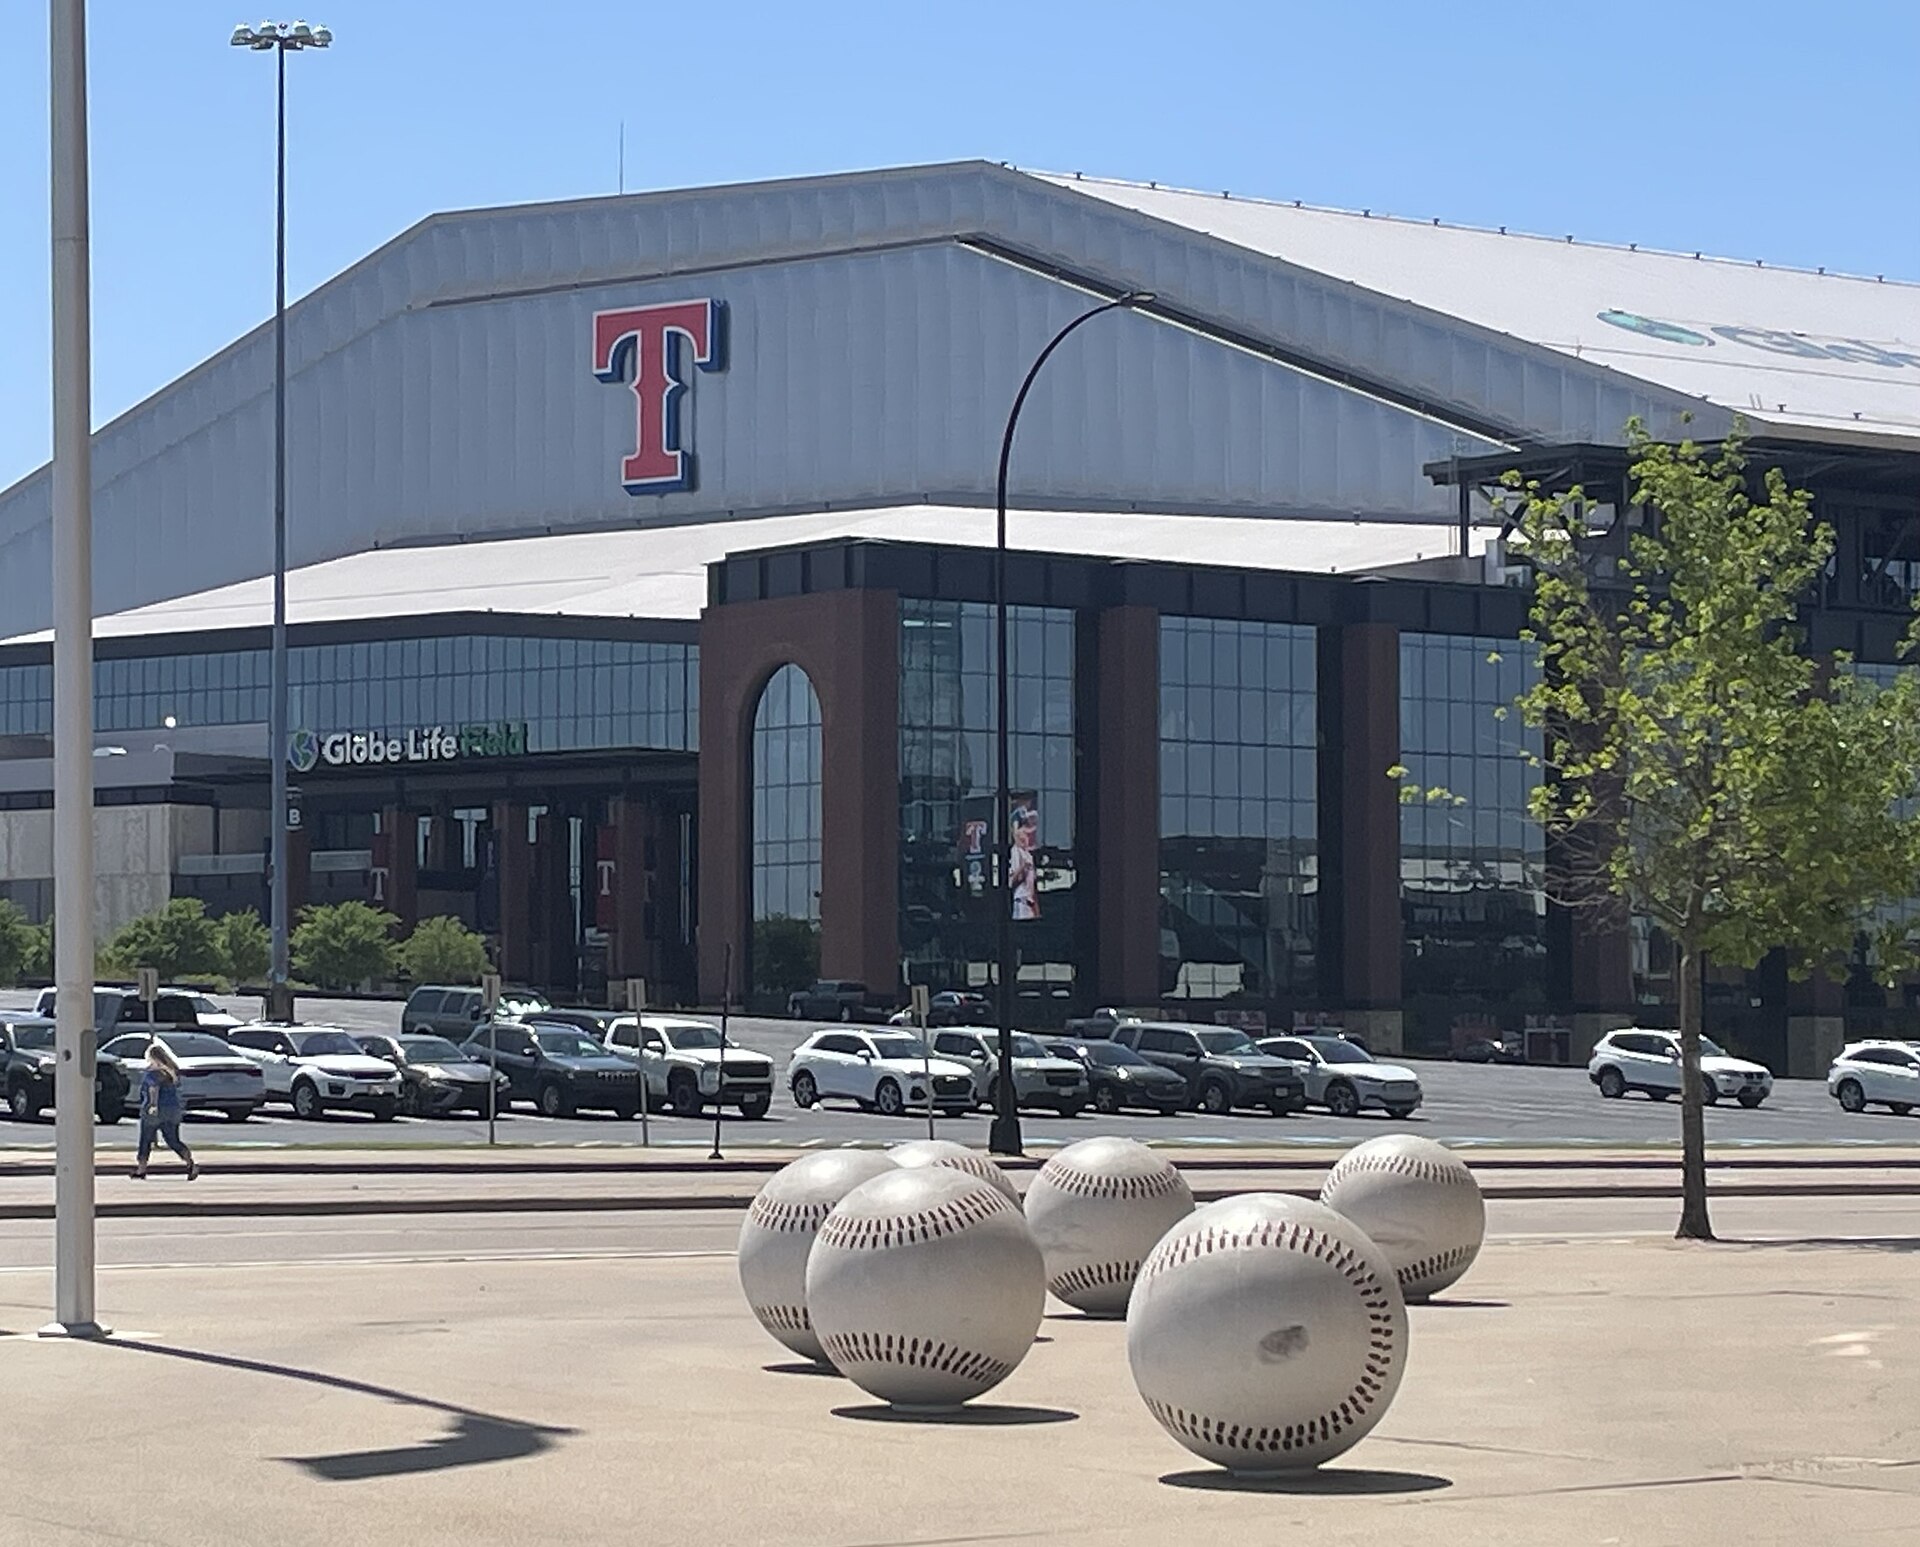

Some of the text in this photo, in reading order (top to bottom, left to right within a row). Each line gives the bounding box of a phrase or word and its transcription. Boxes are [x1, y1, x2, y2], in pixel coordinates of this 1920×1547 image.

[593, 298, 720, 493] T
[322, 723, 527, 764] Globe Life Field
[289, 809, 300, 824] B
[965, 821, 987, 853] T
[370, 868, 389, 900] T
[597, 861, 615, 895] T
